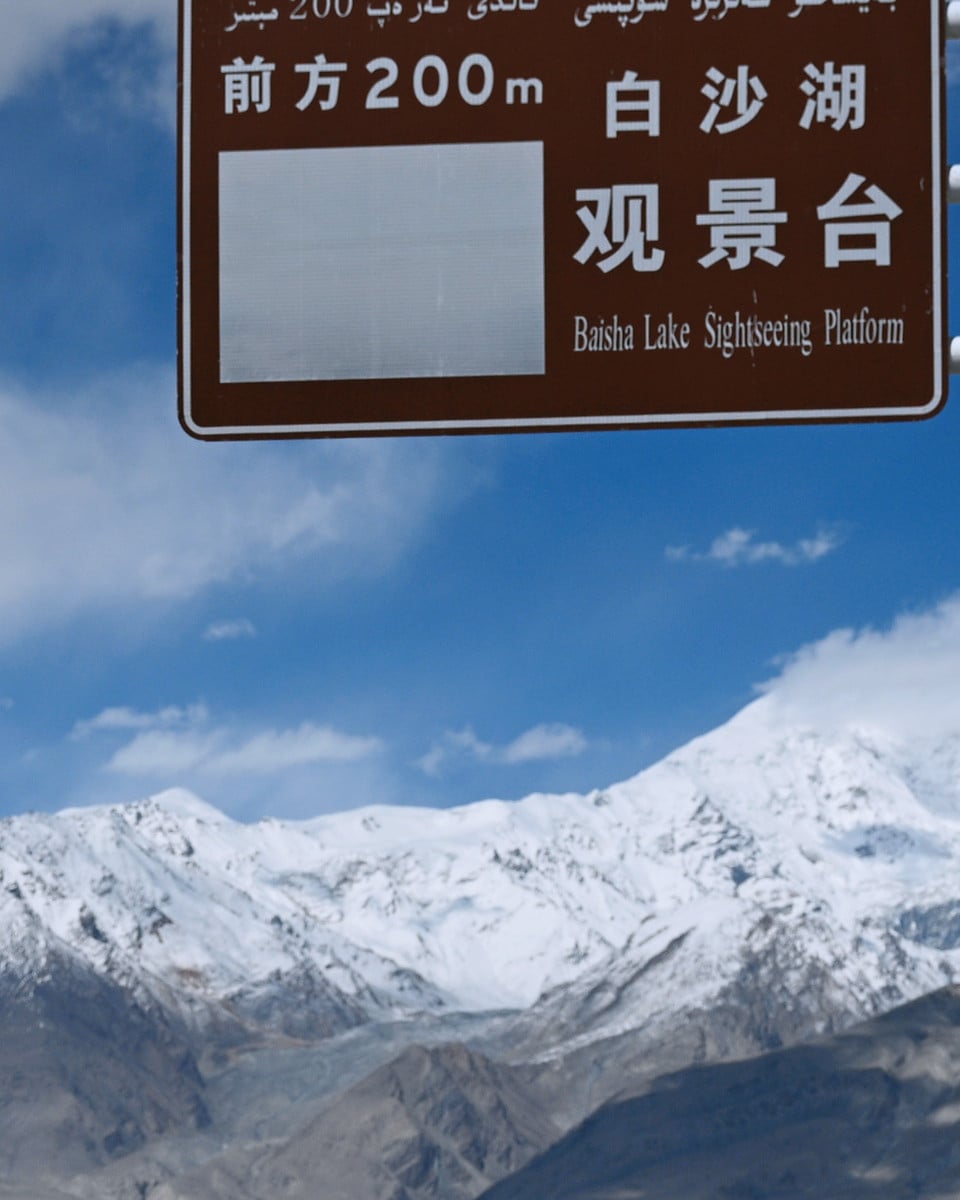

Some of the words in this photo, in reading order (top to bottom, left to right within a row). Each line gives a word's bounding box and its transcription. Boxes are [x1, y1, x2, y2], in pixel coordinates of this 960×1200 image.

[606, 61, 866, 138] 白沙湖
[572, 172, 903, 274] 观景台
[574, 314, 634, 352] Baisha
[643, 312, 690, 350] Lake
[704, 310, 813, 358] Sightseeing
[824, 306, 904, 346] Platform
